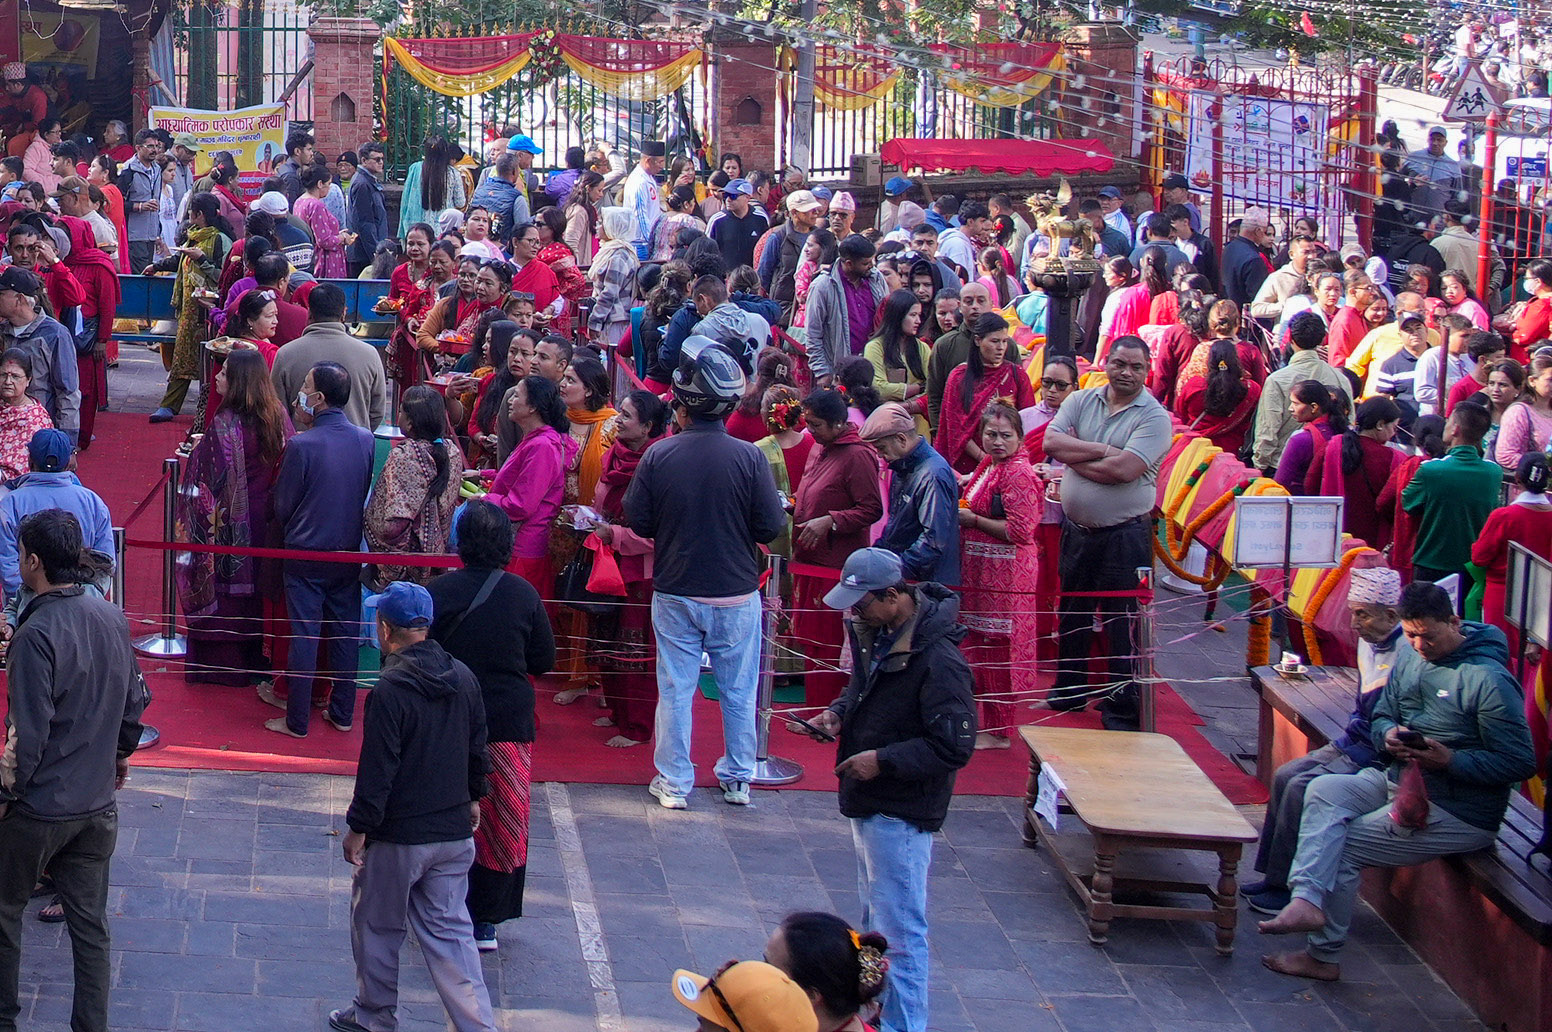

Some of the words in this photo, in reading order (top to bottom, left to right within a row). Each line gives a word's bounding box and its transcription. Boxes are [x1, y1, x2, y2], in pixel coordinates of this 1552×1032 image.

[155, 117, 210, 133] आध्यात्मिक
[212, 116, 255, 132] परोपकार
[257, 113, 282, 130] संस्था
